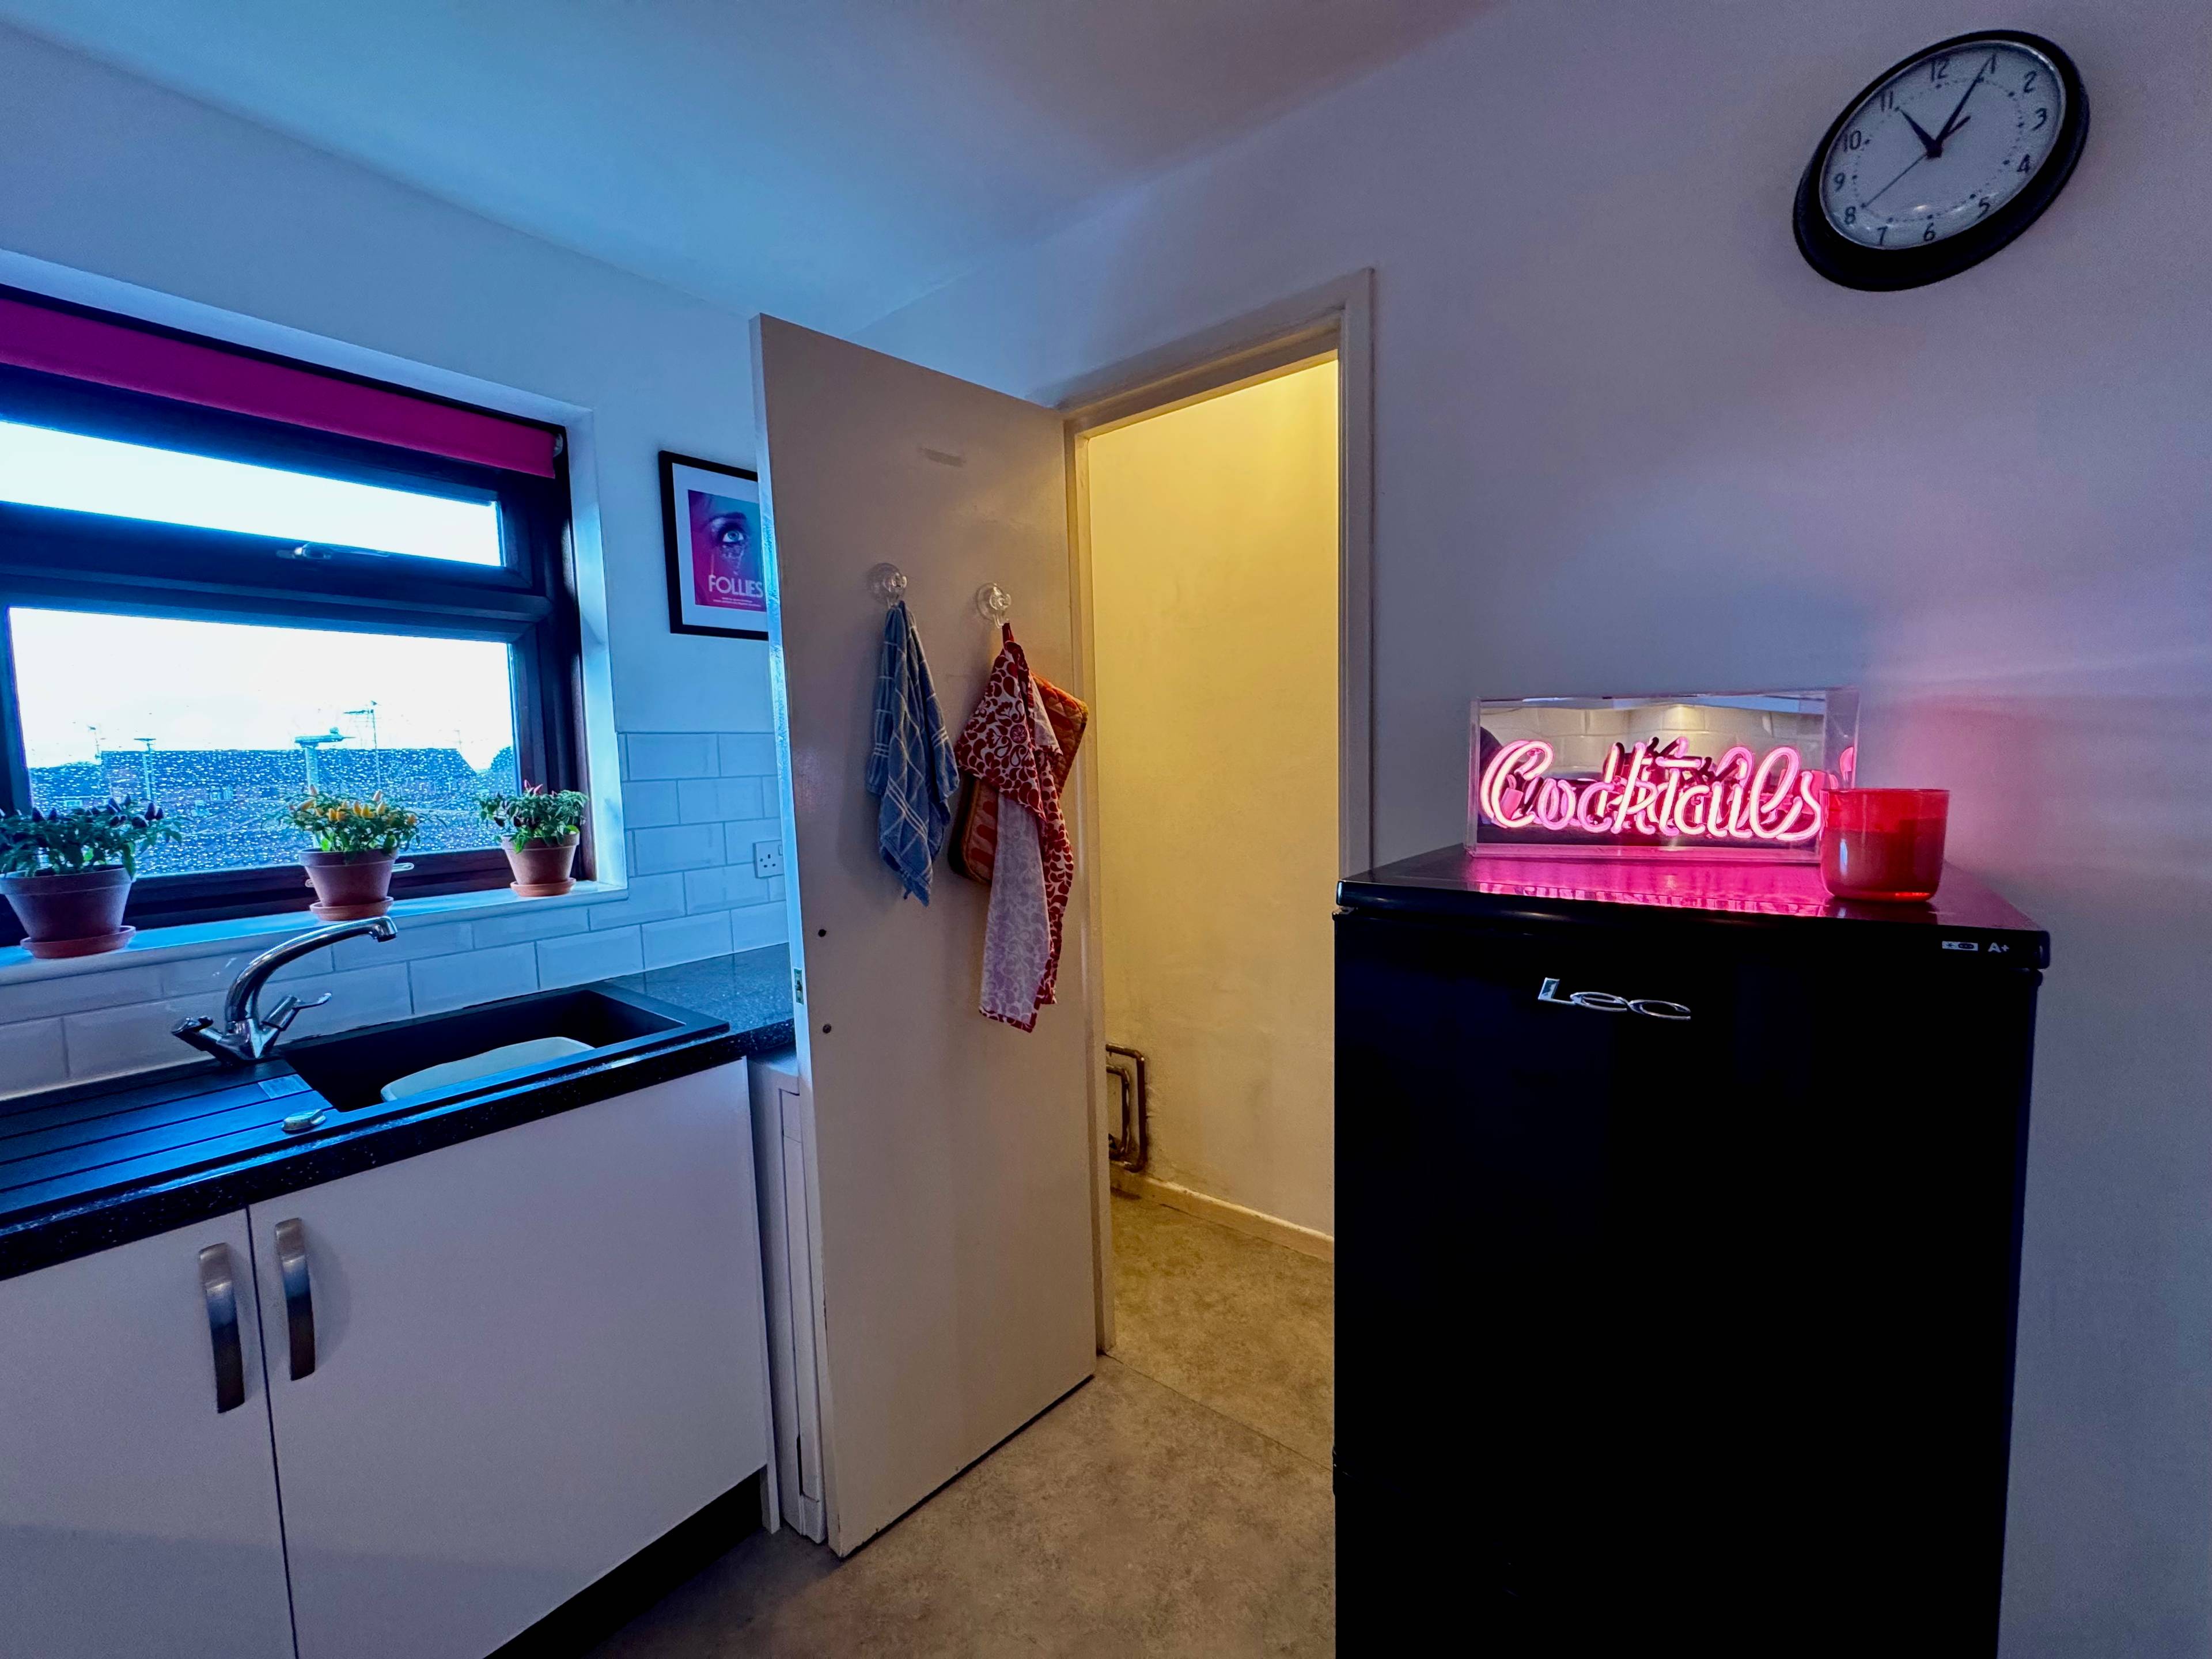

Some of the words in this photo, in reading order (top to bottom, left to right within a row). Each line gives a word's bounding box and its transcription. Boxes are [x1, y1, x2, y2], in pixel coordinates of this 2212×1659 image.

[1930, 60, 1949, 82] 12
[2023, 70, 2038, 94] 2
[1880, 90, 1895, 112] 11
[2032, 107, 2048, 131] 3
[1843, 130, 1862, 152] 10
[2016, 154, 2031, 173] 4
[1834, 172, 1846, 192] 9
[1844, 206, 1857, 226] 8
[1978, 196, 1992, 219] 5
[1877, 225, 1889, 246] 7
[1923, 222, 1936, 241] 6
[709, 575, 763, 598] FOLLIES
[1481, 738, 1822, 842] Cocktails
[1988, 942, 2010, 953] A+
